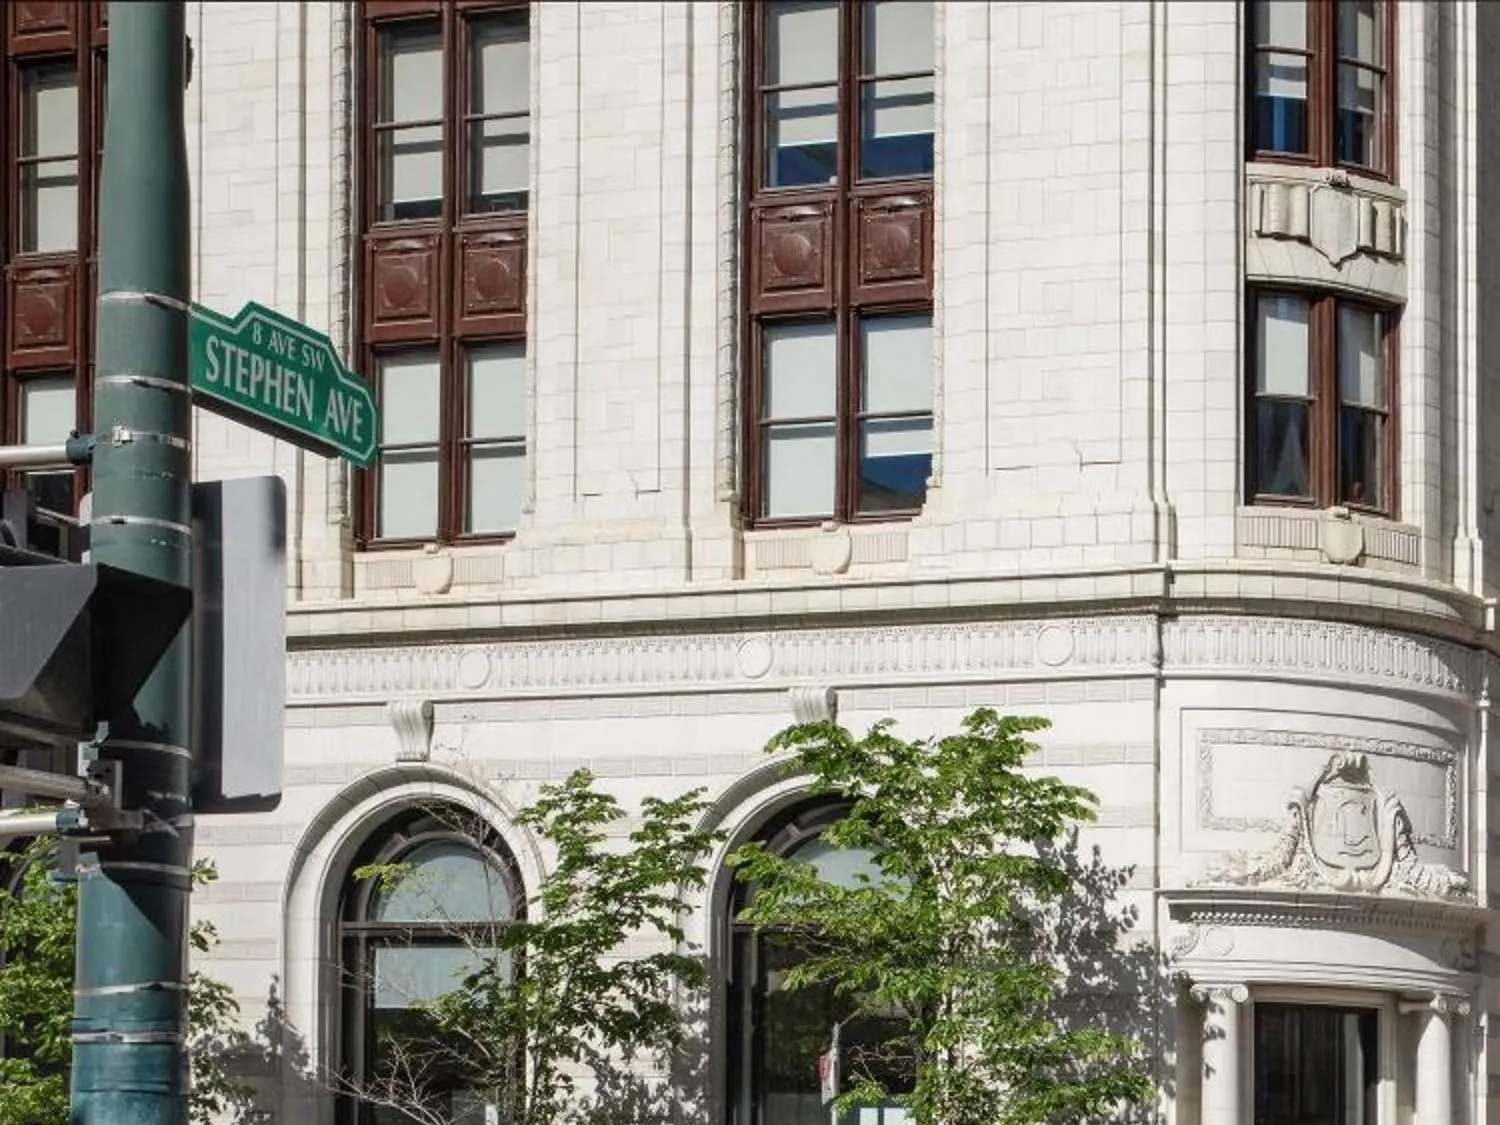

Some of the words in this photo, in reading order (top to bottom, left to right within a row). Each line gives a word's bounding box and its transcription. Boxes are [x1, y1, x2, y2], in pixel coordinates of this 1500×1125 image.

[252, 321, 262, 345] 8
[268, 328, 296, 360] AVE
[302, 344, 326, 373] SW
[205, 334, 315, 422] STEPHEN
[323, 387, 363, 443] AVE
